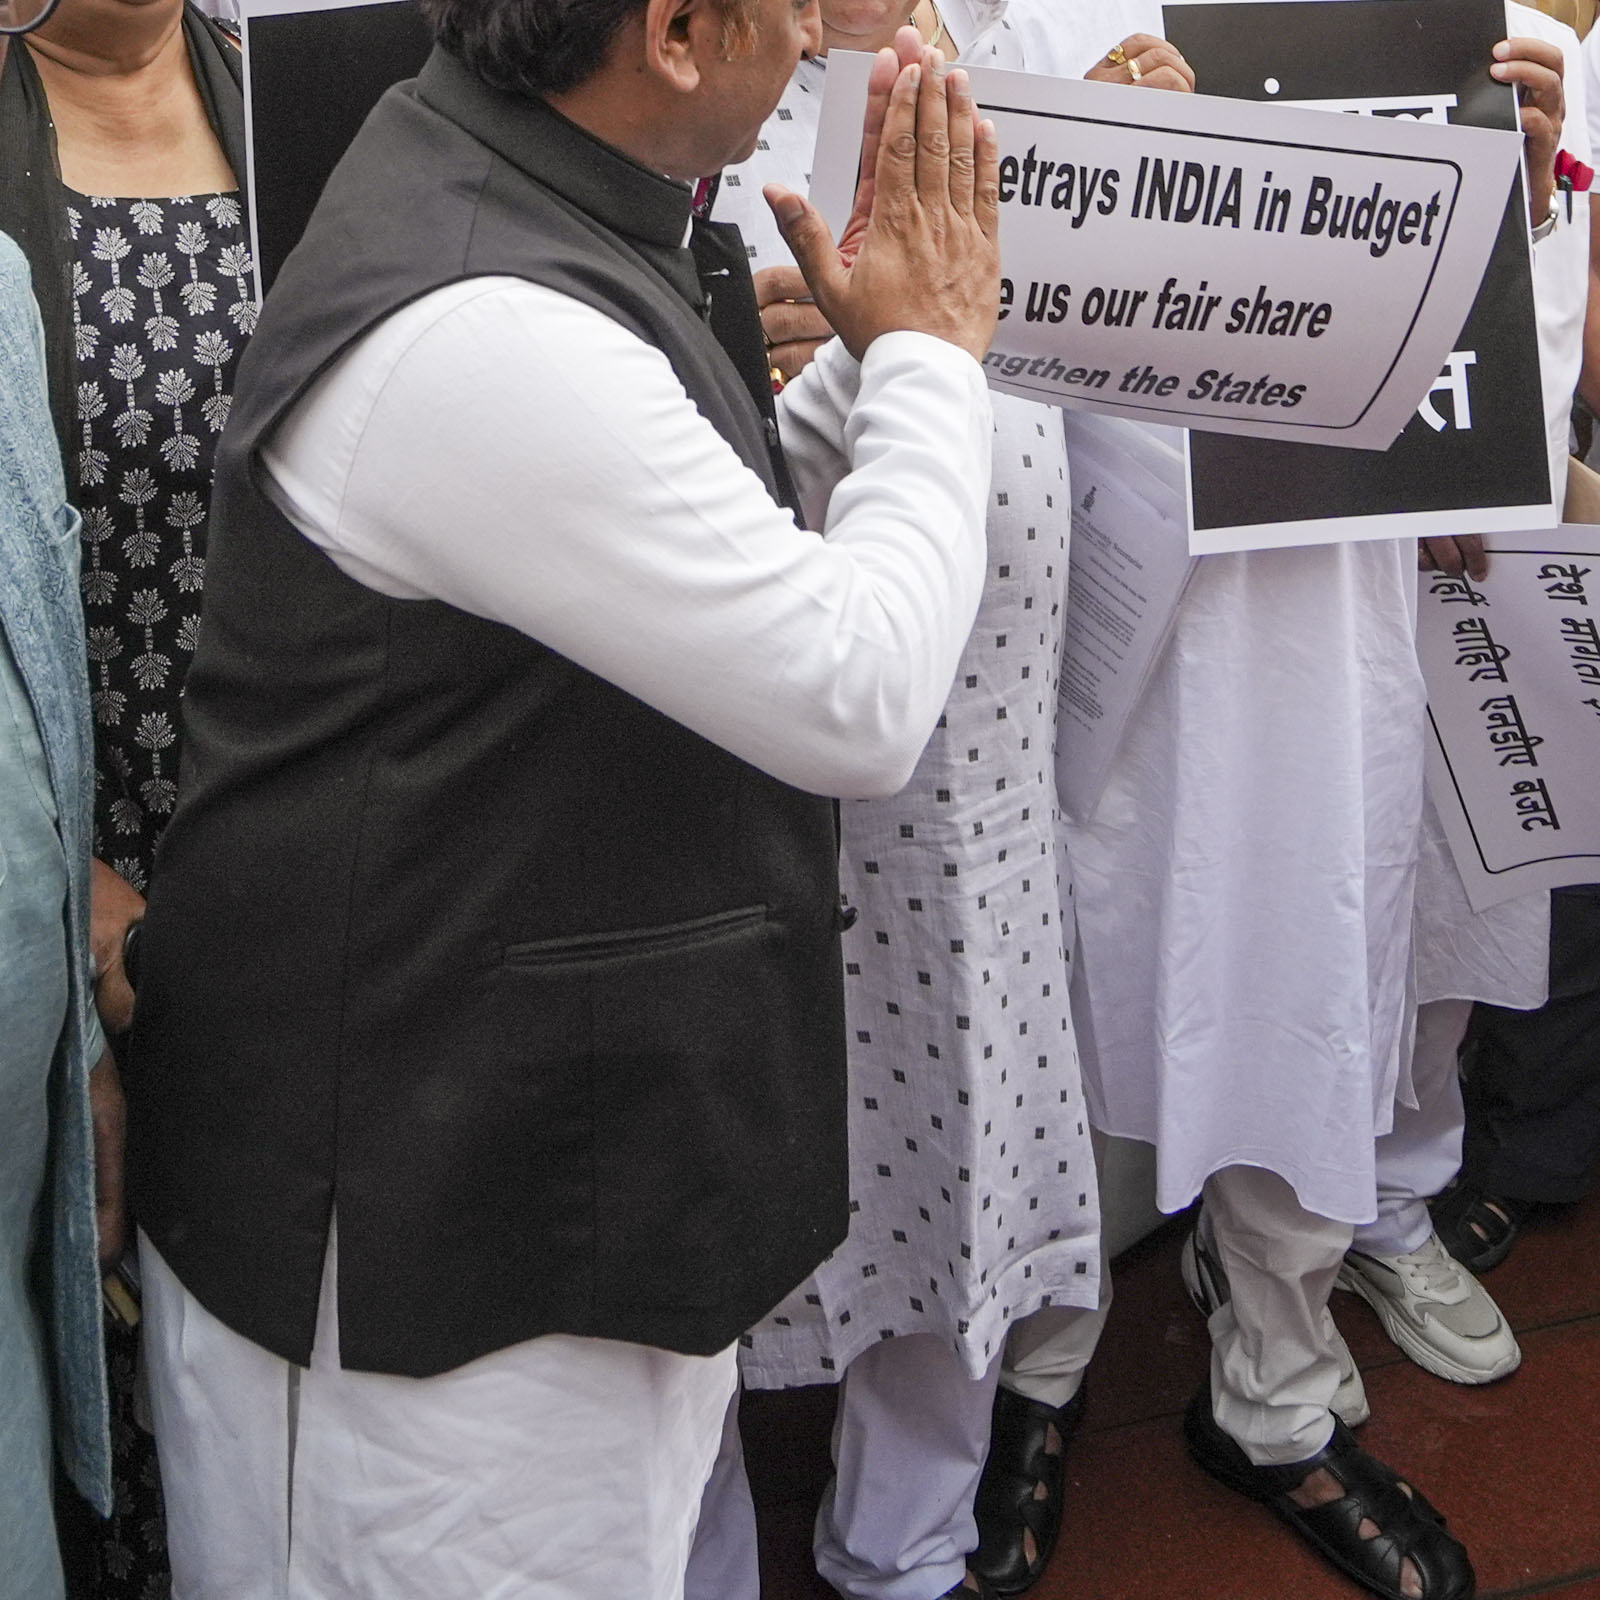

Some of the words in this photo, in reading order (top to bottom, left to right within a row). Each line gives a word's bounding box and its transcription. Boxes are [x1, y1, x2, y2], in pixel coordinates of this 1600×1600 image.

[999, 143, 1120, 228] etrays
[1131, 156, 1243, 229] INDIA
[1254, 171, 1291, 232] in
[1301, 176, 1442, 257] Budget
[1025, 281, 1071, 324] us
[1081, 285, 1148, 328] our
[1152, 278, 1222, 331] fair
[1225, 285, 1333, 338] share
[982, 351, 1111, 389] ngthen
[1118, 366, 1180, 397] the
[1187, 369, 1307, 408] States
[1536, 563, 1590, 605] देश
[1452, 617, 1511, 683] चाहिए
[1479, 695, 1544, 767] एनडीए
[1509, 778, 1561, 832] बजट
